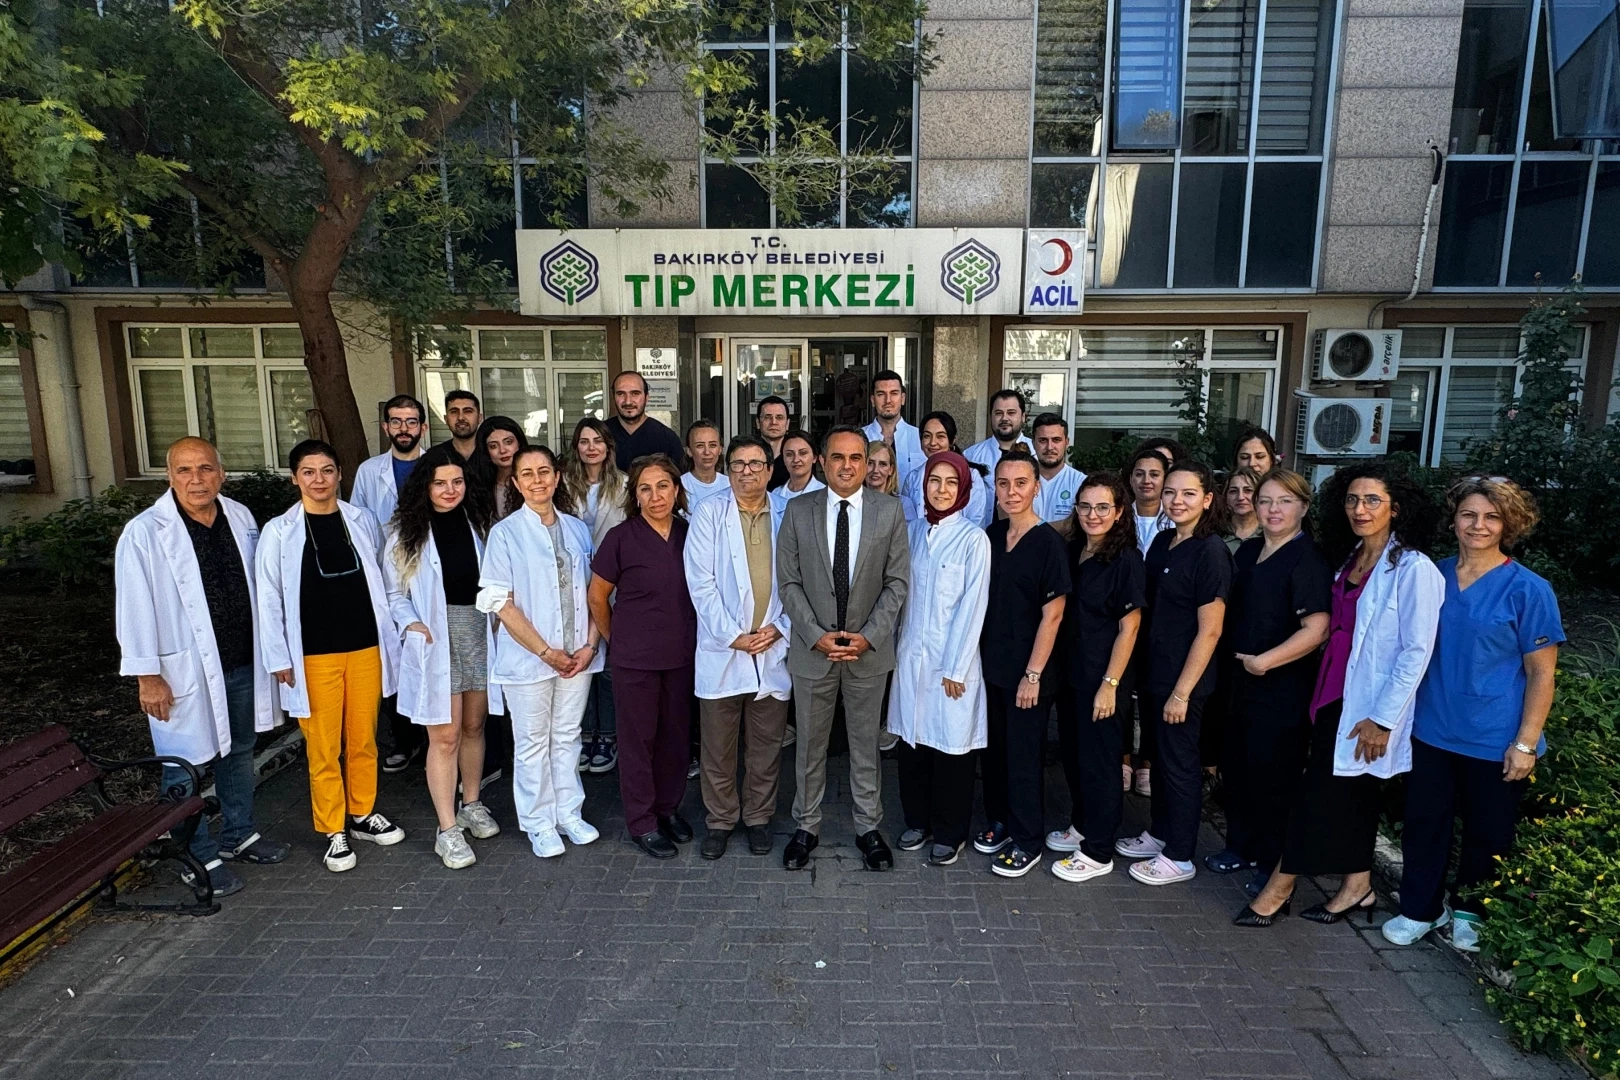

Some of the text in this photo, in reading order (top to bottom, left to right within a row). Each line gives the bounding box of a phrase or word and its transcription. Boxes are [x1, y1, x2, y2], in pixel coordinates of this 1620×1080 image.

[751, 236, 787, 248] T.C.
[654, 250, 884, 265] BAKIRKÖY BELEDİYESİ
[624, 264, 915, 308] TIP MERKEZİ
[1029, 279, 1079, 307] ACİL
[1383, 334, 1394, 366] arçelik
